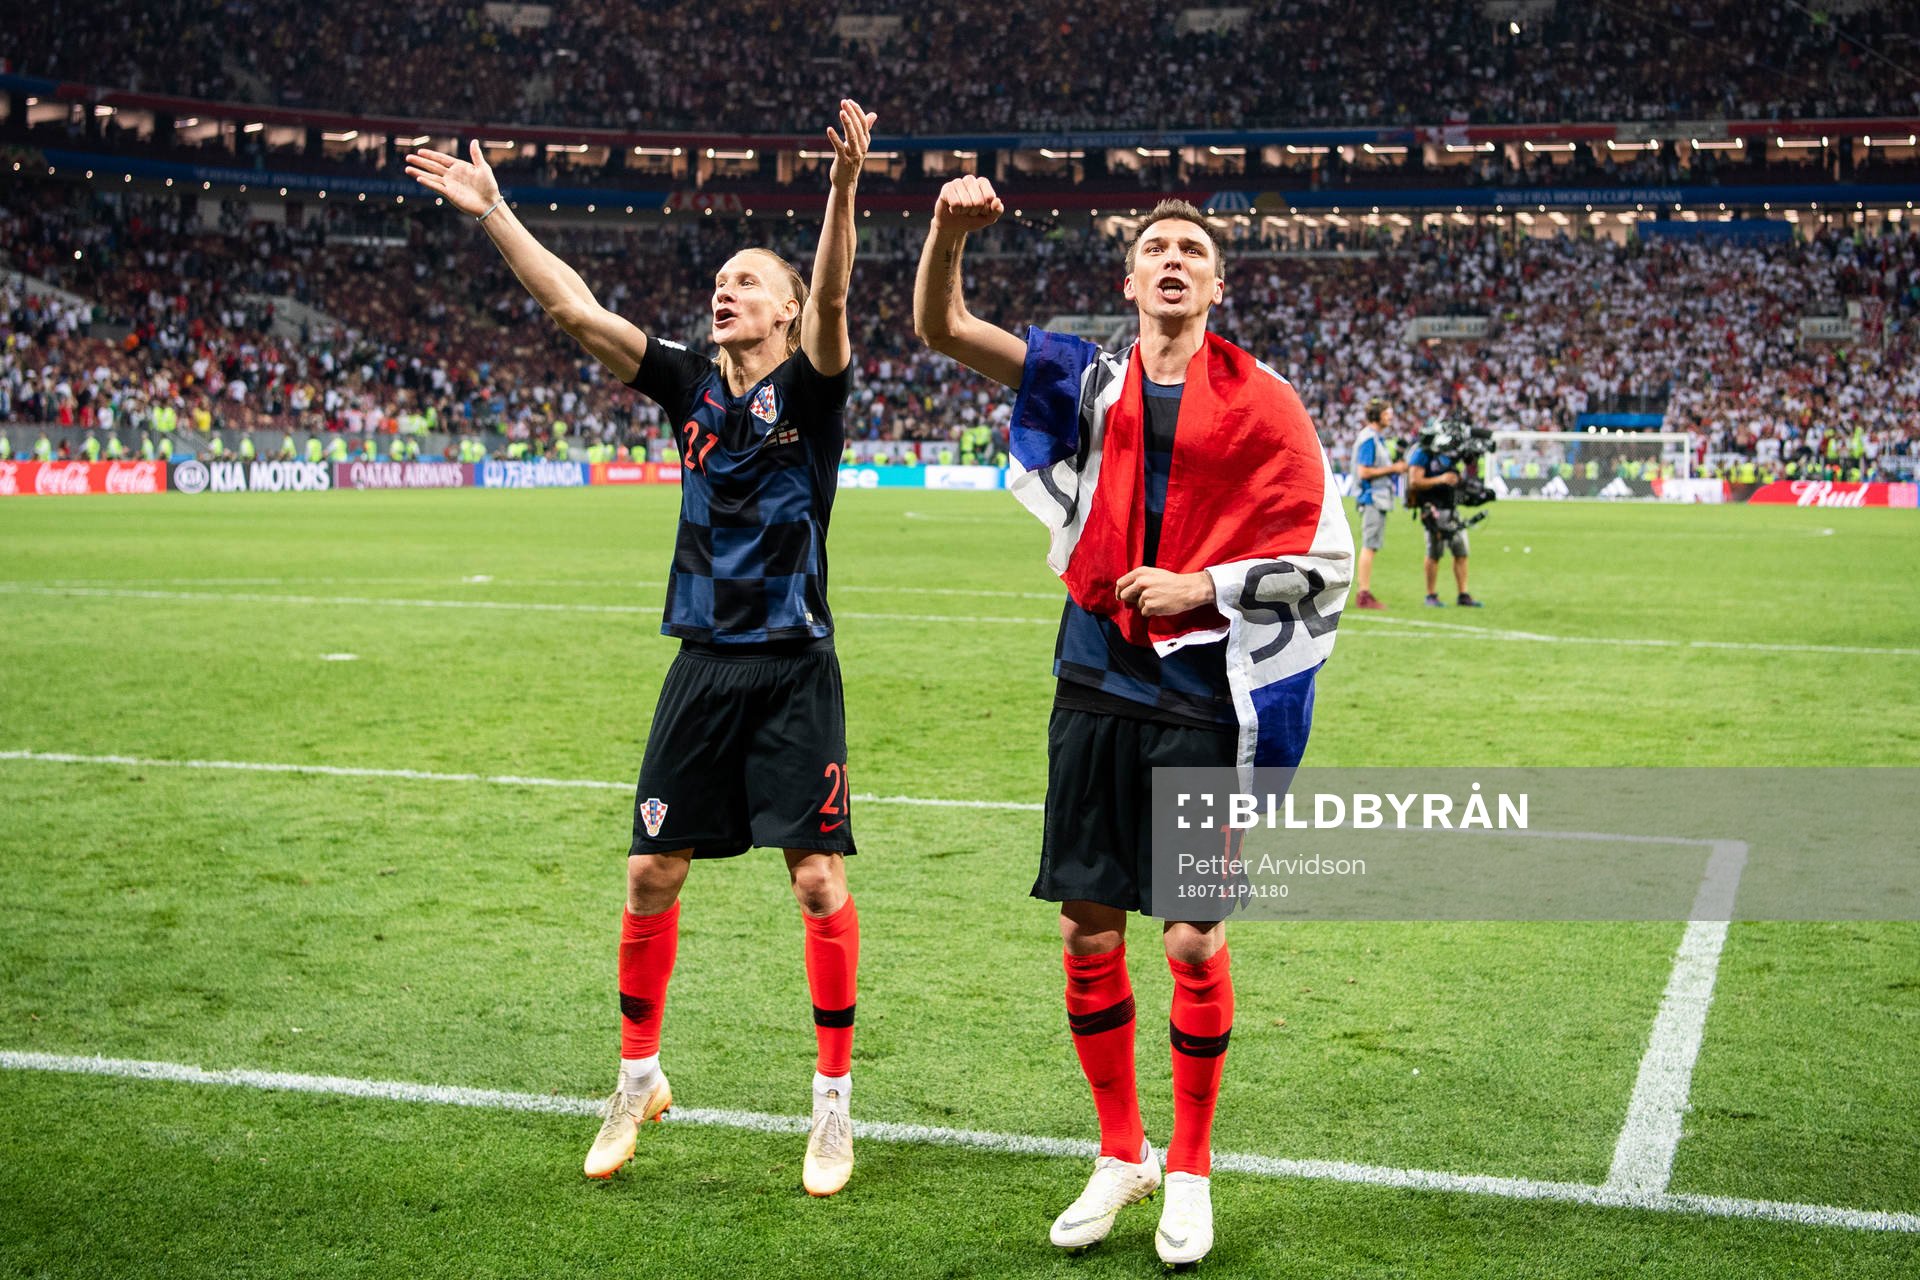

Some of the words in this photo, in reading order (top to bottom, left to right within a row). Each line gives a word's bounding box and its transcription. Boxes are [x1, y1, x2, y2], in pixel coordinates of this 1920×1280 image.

[683, 420, 719, 477] 21
[210, 461, 247, 492] KIA
[250, 460, 330, 492] MOTORS
[350, 462, 402, 490] QATAR
[1790, 480, 1869, 508] Bud
[818, 762, 848, 815] 21
